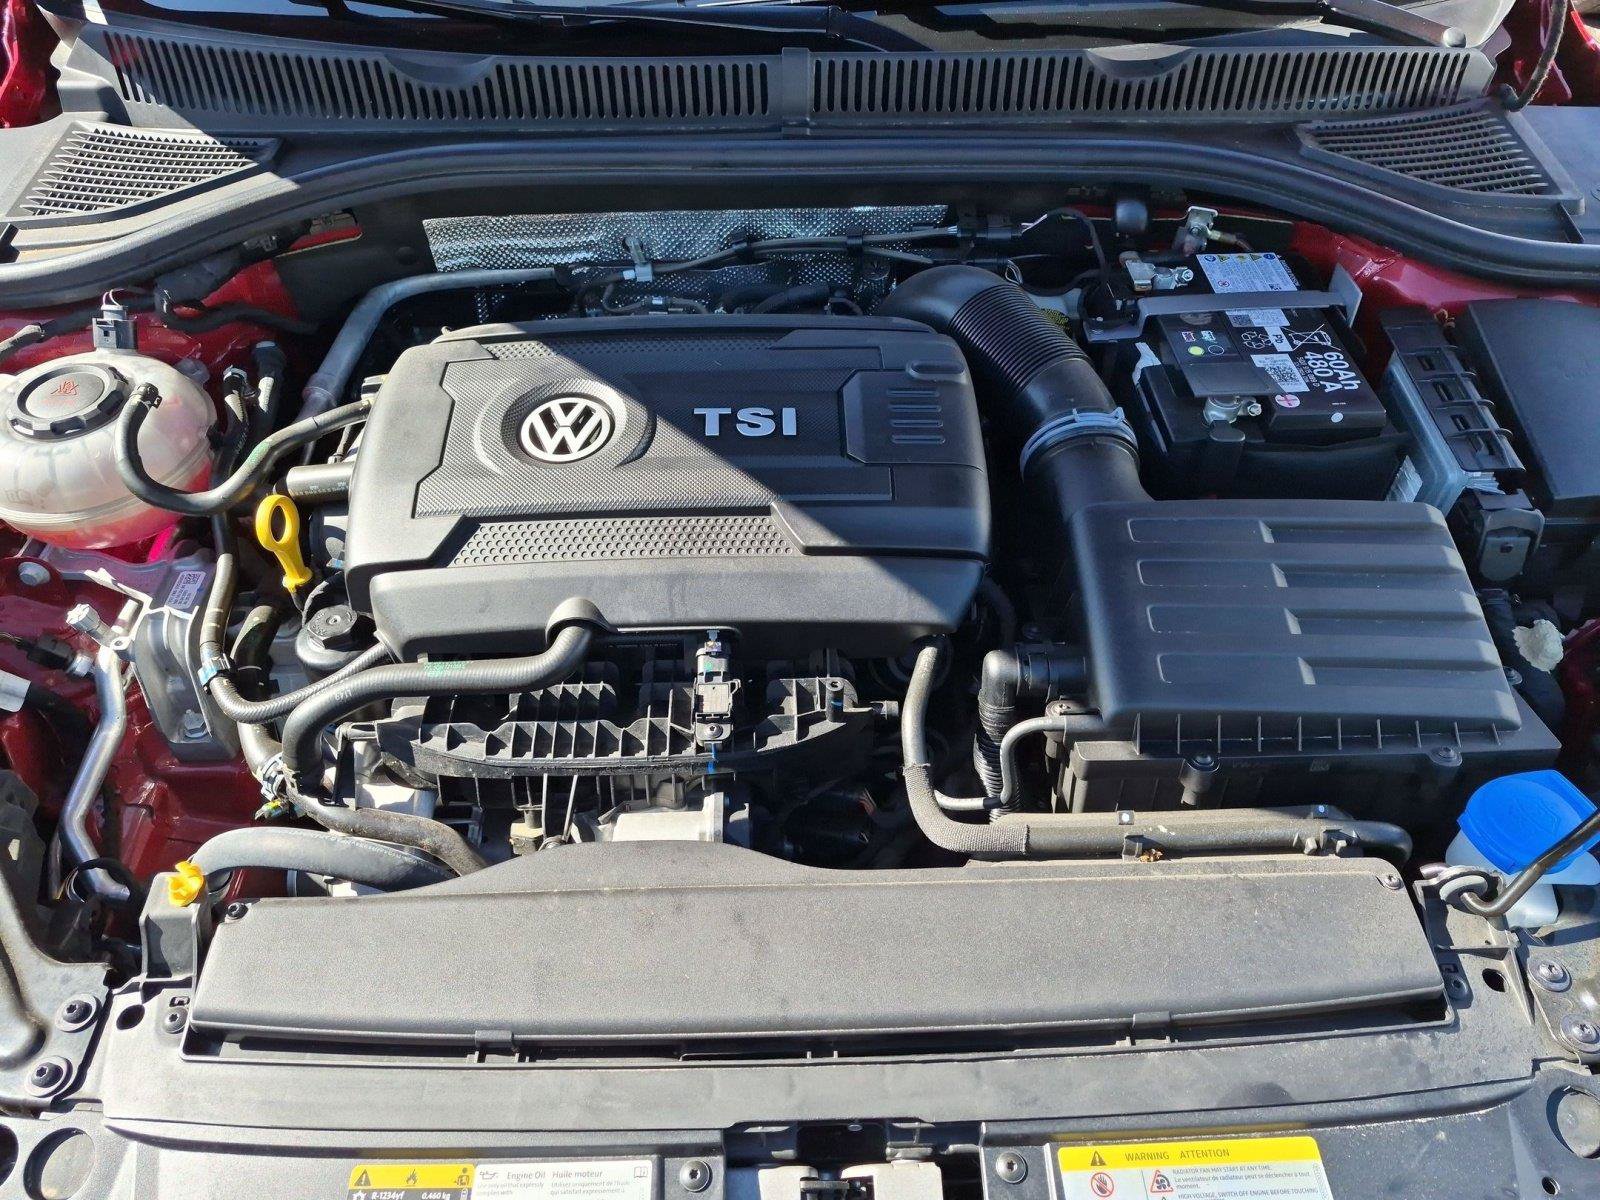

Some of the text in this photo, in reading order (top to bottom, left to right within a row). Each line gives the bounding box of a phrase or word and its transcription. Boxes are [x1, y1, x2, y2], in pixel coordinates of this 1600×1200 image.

[1272, 334, 1284, 344] Pb
[1304, 351, 1334, 377] 480
[1319, 380, 1343, 393] A
[1323, 351, 1361, 390] 60Ah
[693, 407, 797, 437] TSI
[1124, 1149, 1230, 1161] WARNING ATTENTION
[507, 1170, 546, 1181] Engine Oil
[552, 1170, 603, 1179] Huile moteur
[371, 1190, 405, 1200] R-1234yf
[441, 1191, 451, 1200] kg
